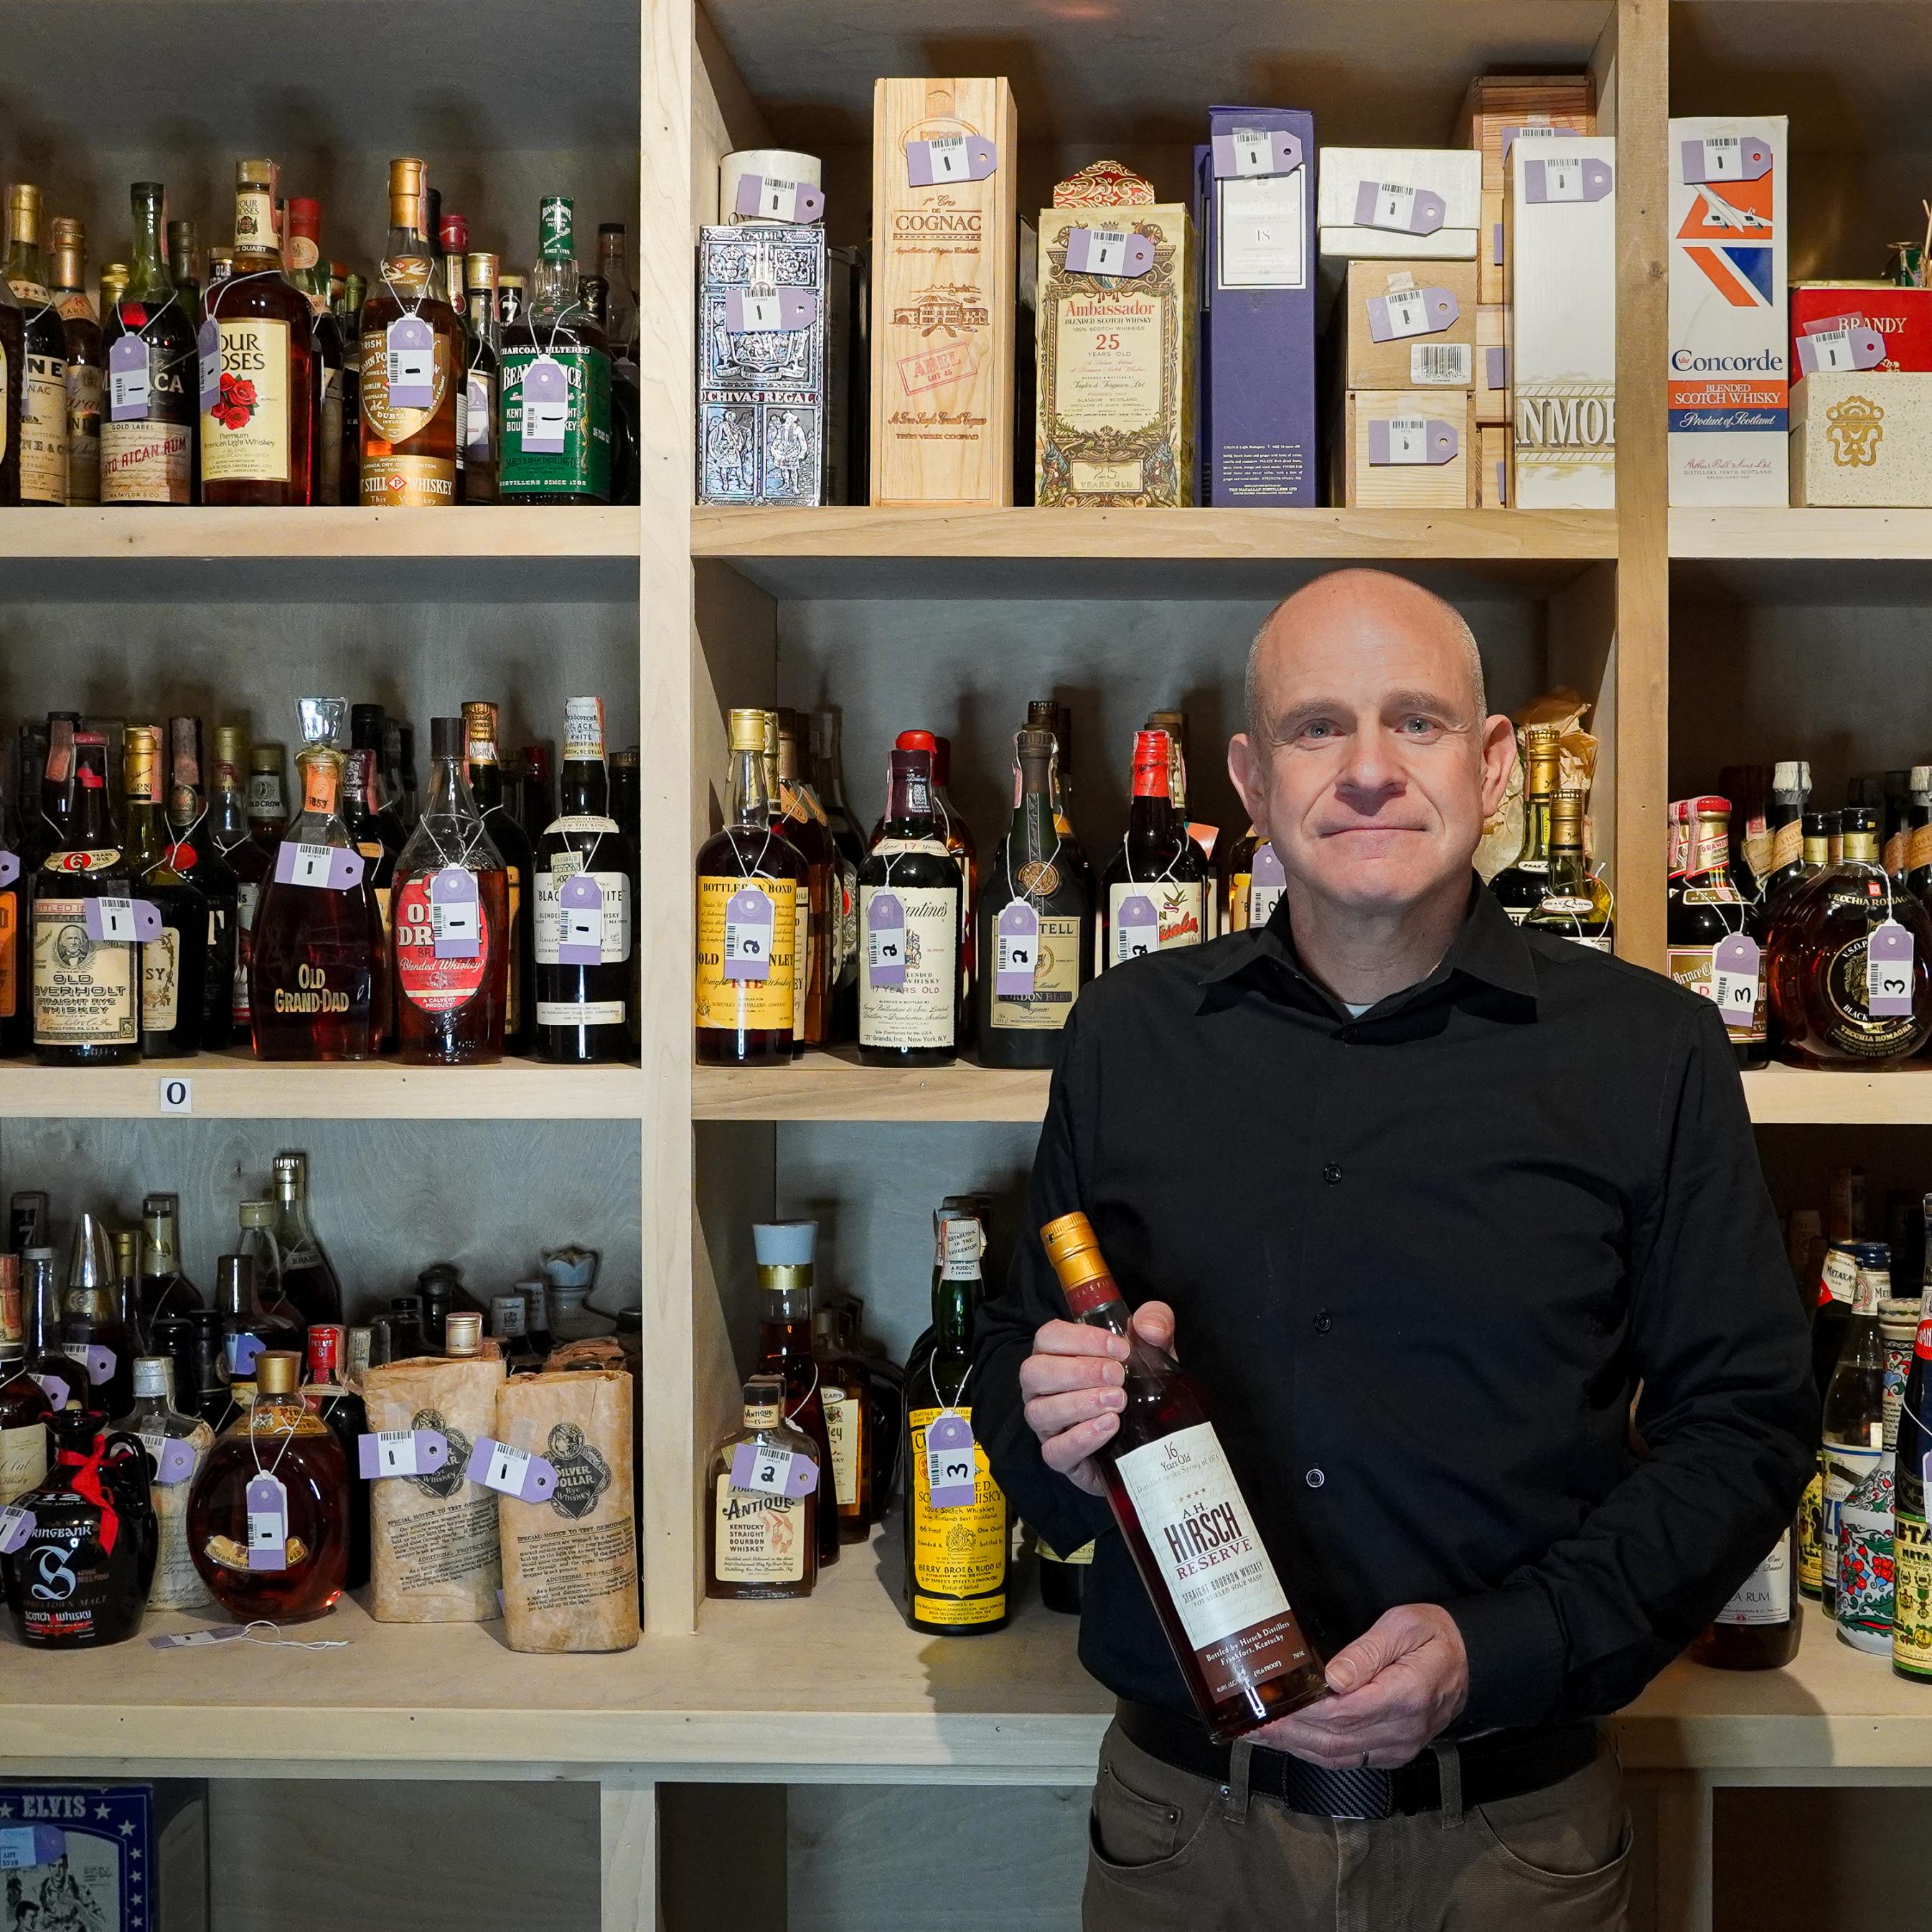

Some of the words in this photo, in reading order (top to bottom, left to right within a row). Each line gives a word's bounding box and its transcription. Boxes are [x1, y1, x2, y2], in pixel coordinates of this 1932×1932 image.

[895, 215, 983, 231] COGNAC
[744, 230, 761, 240] 750
[763, 230, 782, 241] ML
[1256, 228, 1271, 243] 18
[1064, 299, 1156, 317] Ambassador
[1838, 317, 1907, 334] BRANDY
[221, 333, 260, 352] OUR
[362, 339, 382, 350] IRISH
[1095, 334, 1120, 350] 25
[545, 346, 591, 355] FILTERED
[221, 352, 266, 372] OSES
[1671, 348, 1783, 372] Concorde
[927, 372, 942, 382] LOT
[1705, 384, 1751, 393] BLENDED
[707, 391, 760, 402] CHIVAS
[764, 392, 816, 403] REGAL
[1675, 392, 1726, 405] SCOTCH
[1729, 392, 1781, 404] WHISKY
[1679, 411, 1724, 428] Product
[1723, 416, 1732, 428] of
[1730, 411, 1776, 426] Scotland
[164, 436, 187, 456] RUM
[245, 439, 276, 448] Whiskey
[1092, 464, 1118, 480] 25
[364, 476, 388, 493] STILL
[407, 477, 453, 496] WHISKEY
[70, 854, 85, 869] 6
[768, 883, 792, 894] BOND
[1828, 893, 1870, 906] VECCHIA
[1038, 923, 1074, 934] TELL
[882, 944, 899, 957] 2
[1011, 949, 1028, 964] 2
[400, 958, 436, 971] Blended
[439, 957, 484, 973] Whiskey
[697, 952, 720, 966] OLD
[52, 974, 94, 985] OLD
[298, 963, 326, 990] OLD
[766, 978, 792, 990] Whiskey
[1734, 986, 1752, 1003] 3
[1883, 979, 1905, 995] 3
[42, 1005, 109, 1015] WHISKEY
[1843, 1004, 1869, 1022] BLACK
[1840, 1024, 1875, 1042] VECCHIA
[1875, 1023, 1913, 1042] ROMAGNA
[745, 1408, 774, 1419] ANTIQUE
[1163, 1441, 1178, 1460] 16
[1160, 1458, 1178, 1472] Years
[1178, 1452, 1191, 1466] Old
[1181, 1461, 1201, 1474] Spring
[1201, 1458, 1209, 1466] of
[422, 1471, 456, 1483] Whiskey
[554, 1464, 592, 1477] SILVER
[761, 1466, 776, 1483] 2
[947, 1463, 969, 1478] 3
[42, 1493, 83, 1502] 12
[556, 1490, 591, 1502] Whiskey
[722, 1496, 795, 1521] ANTIQUE
[1182, 1501, 1209, 1520] A.H.
[388, 1516, 411, 1526] SPECIAL
[413, 1510, 436, 1521] NOTICE
[517, 1534, 542, 1542] SPECIAL
[543, 1530, 567, 1539] NOTICE
[1163, 1501, 1242, 1564] HIRSCH
[417, 1551, 454, 1563] ADDITIONAL
[1174, 1539, 1253, 1580] RESERVE
[29, 1544, 77, 1600] S
[918, 1564, 941, 1573] BERRY
[545, 1573, 583, 1583] ADDITIONAL
[1181, 1582, 1209, 1604] STRAIGHT
[1210, 1570, 1239, 1591] BOURBON
[1239, 1561, 1265, 1578] WHISKEY
[1247, 1574, 1263, 1585] MASH
[1745, 1592, 1770, 1603] RUM
[1206, 1646, 1229, 1662] Bottled
[1229, 1643, 1239, 1651] by
[1239, 1633, 1262, 1647] Hirsch
[1262, 1621, 1290, 1637] Distillers
[1255, 1633, 1285, 1651] Kentucky
[22, 1795, 87, 1818] ELVIS
